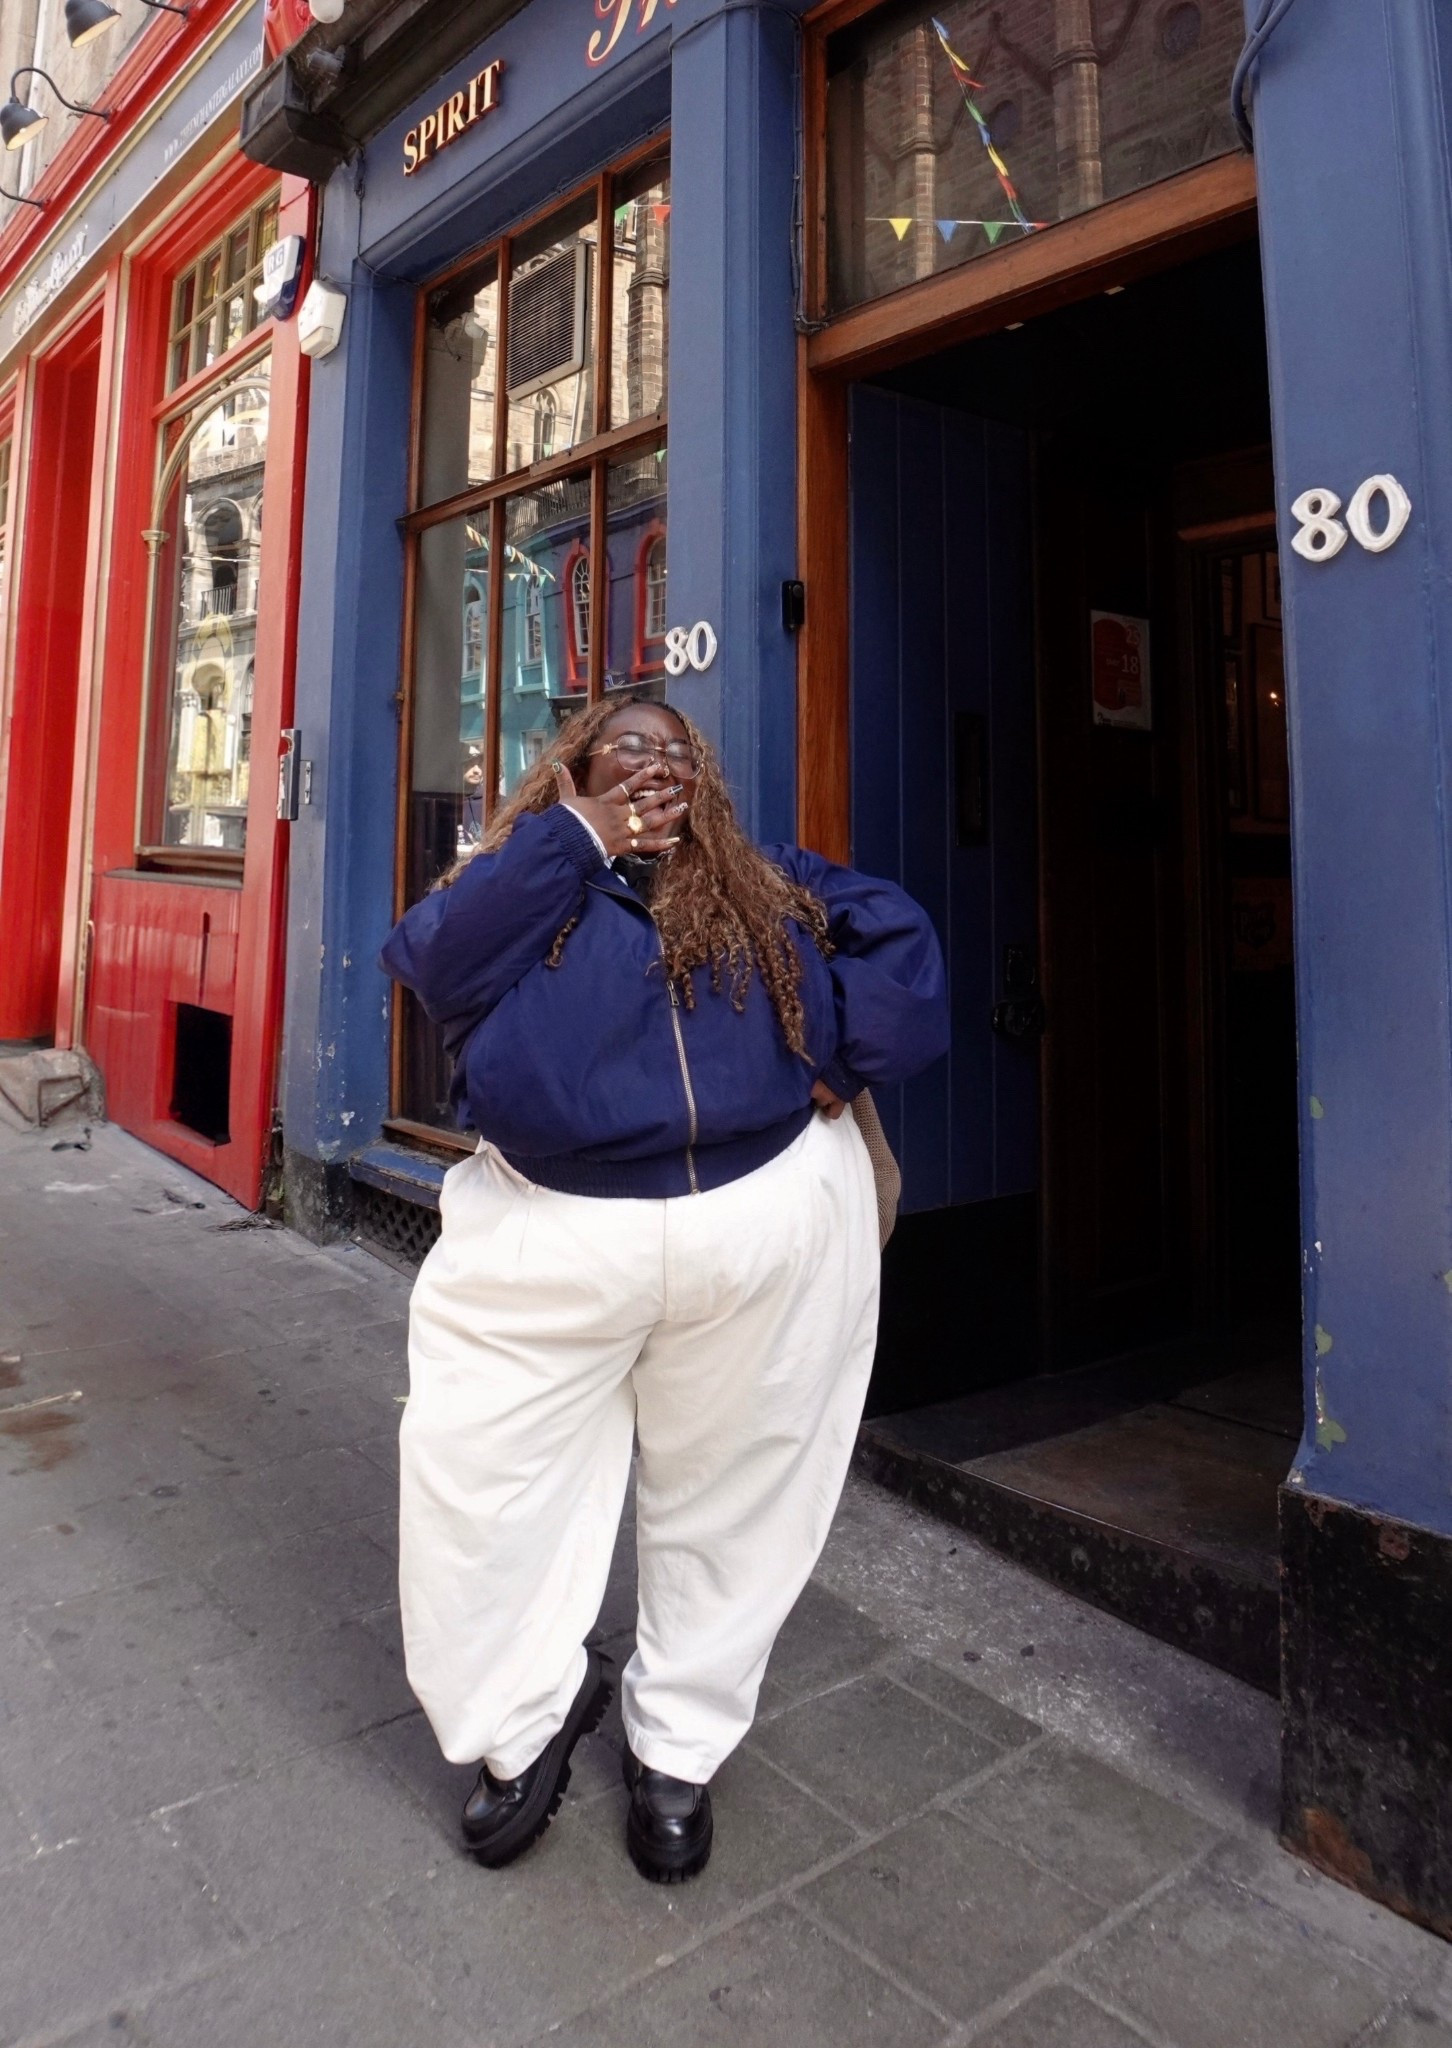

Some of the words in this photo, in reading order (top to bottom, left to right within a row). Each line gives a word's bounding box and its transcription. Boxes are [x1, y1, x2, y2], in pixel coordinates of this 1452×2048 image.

[403, 58, 504, 177] SPIRIT
[1290, 473, 1412, 563] 80
[664, 621, 718, 676] 80
[1121, 653, 1139, 674] 18
